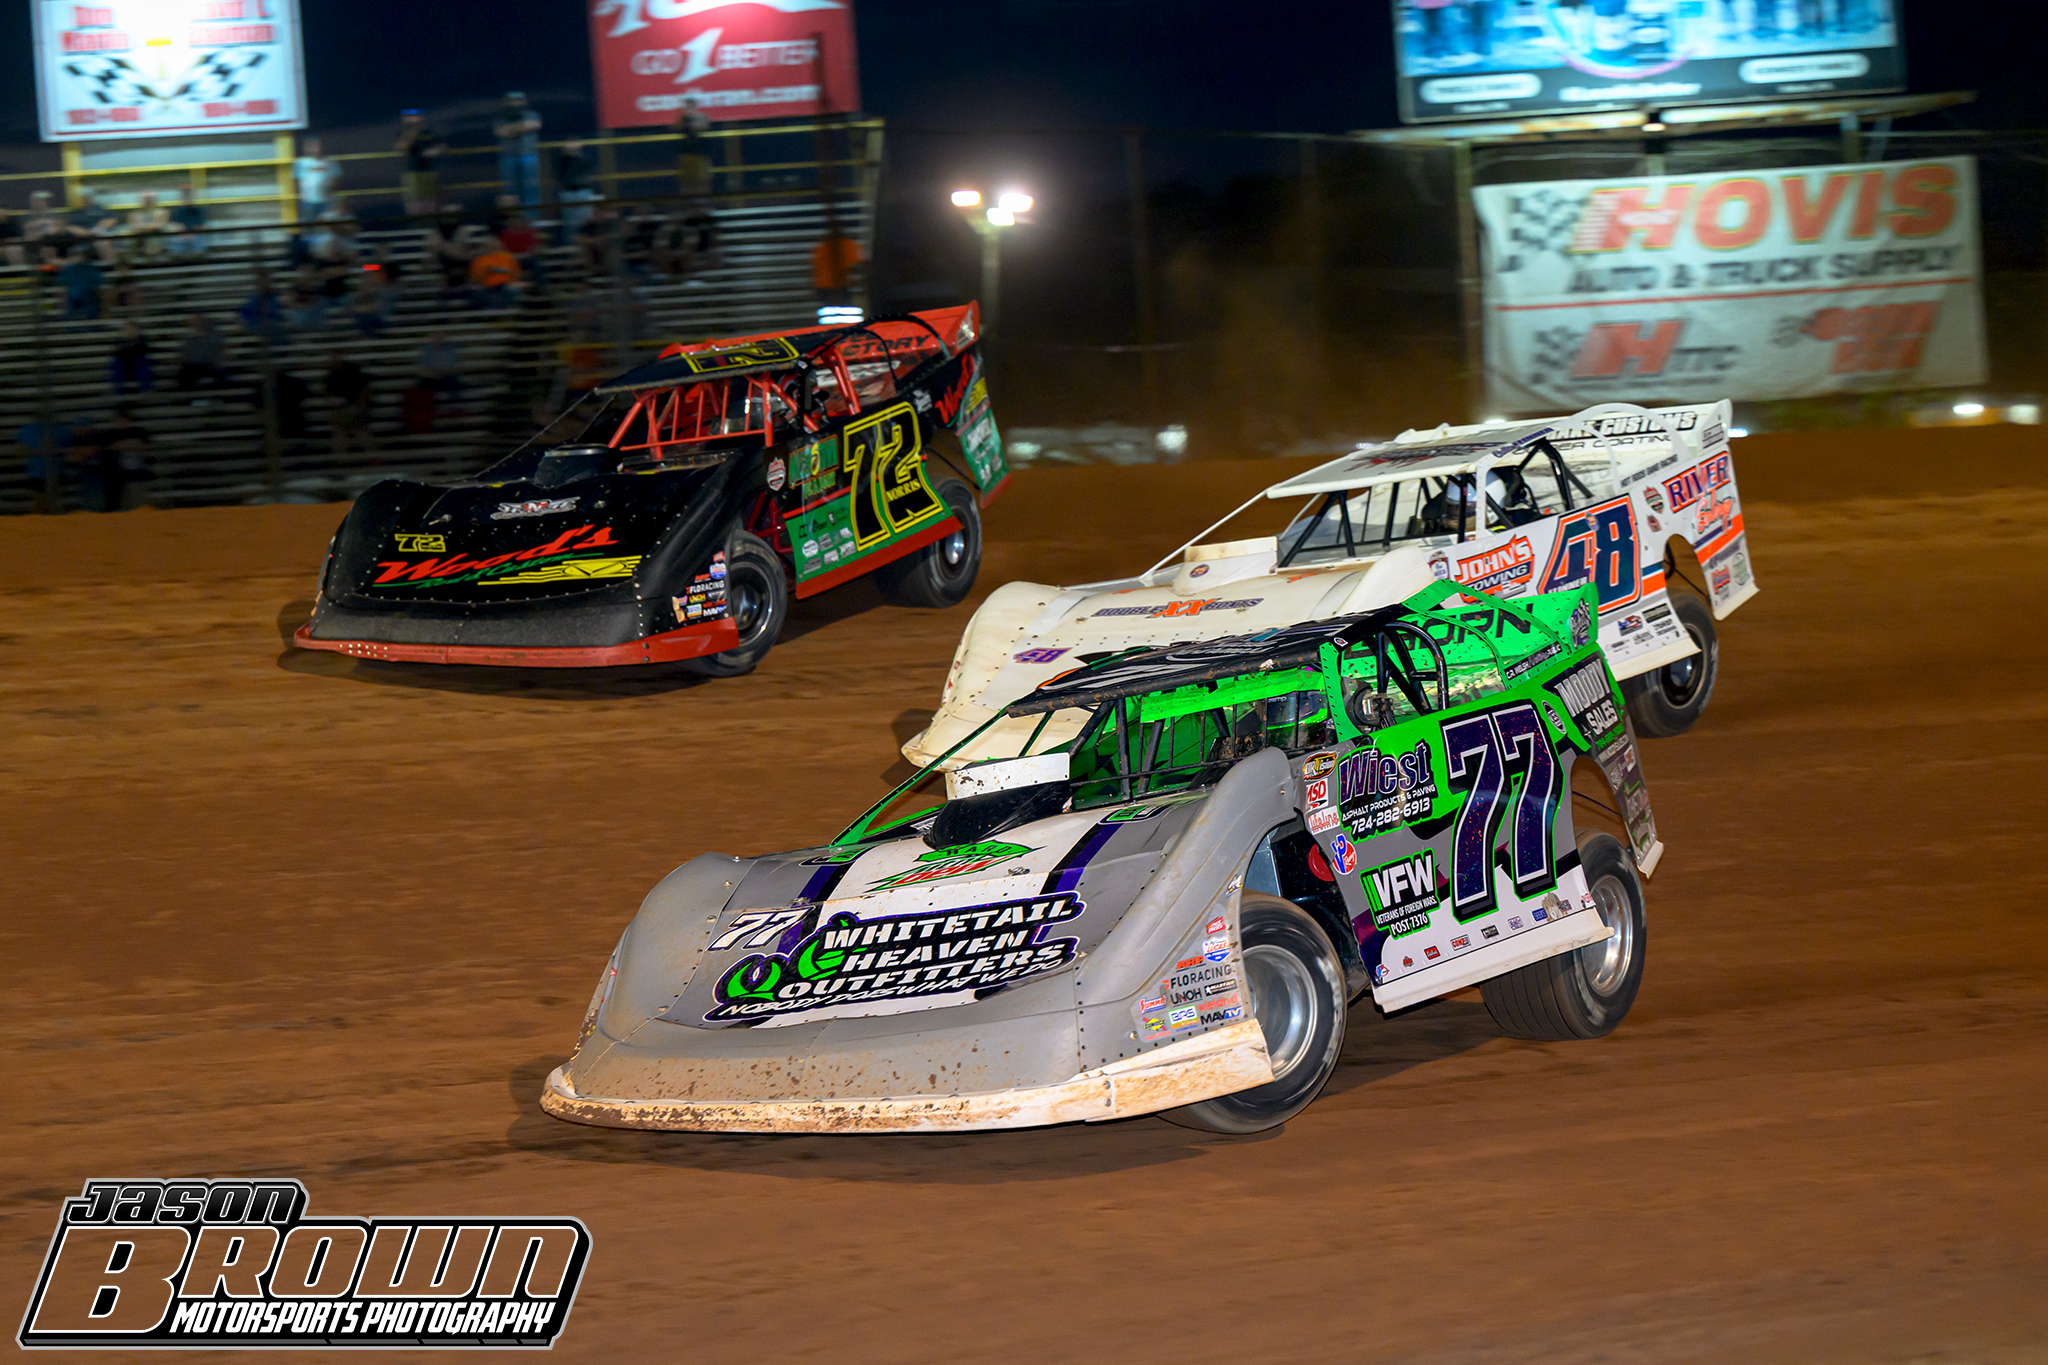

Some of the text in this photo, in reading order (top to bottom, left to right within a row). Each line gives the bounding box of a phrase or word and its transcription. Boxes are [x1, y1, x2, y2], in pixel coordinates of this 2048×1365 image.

[631, 49, 682, 75] GO
[716, 39, 819, 70] BETTER
[1570, 164, 1957, 253] HOVIS
[1566, 245, 1962, 294] AUTO & TRUCK SUPPLY
[843, 401, 944, 552] 72
[1668, 455, 1729, 508] RIVER
[1457, 541, 1531, 583] JOHN'S
[1538, 493, 1643, 614] 48
[1554, 658, 1611, 718] MOODY
[1586, 699, 1619, 736] SALES
[1339, 743, 1430, 806] Wiest
[1342, 805, 1370, 822] ASPHALT
[1370, 794, 1407, 813] PRODUCTS
[1412, 784, 1436, 799] PAVING
[1351, 796, 1431, 835] 724-282-6913
[1441, 702, 1563, 922] 77
[946, 844, 1012, 857] HARD
[1371, 854, 1434, 908] VFW
[706, 905, 816, 951] 77
[823, 899, 1073, 950] WHITETAIL
[1375, 895, 1438, 925] VETERANS OF FOREIGN WARS
[1390, 912, 1429, 936] POST 7376
[842, 930, 1029, 973] HEAVEN
[1176, 955, 1205, 970] ARP
[1206, 941, 1228, 953] LUCAS
[718, 958, 1064, 1016] NOBODY DOES WHAT WE DO
[778, 943, 1067, 999] OUTFITTERS
[1170, 964, 1232, 990] FLORACING
[1170, 987, 1203, 1005] UNOH
[1197, 994, 1239, 1012] wieland
[1200, 1006, 1243, 1025] MAVTV
